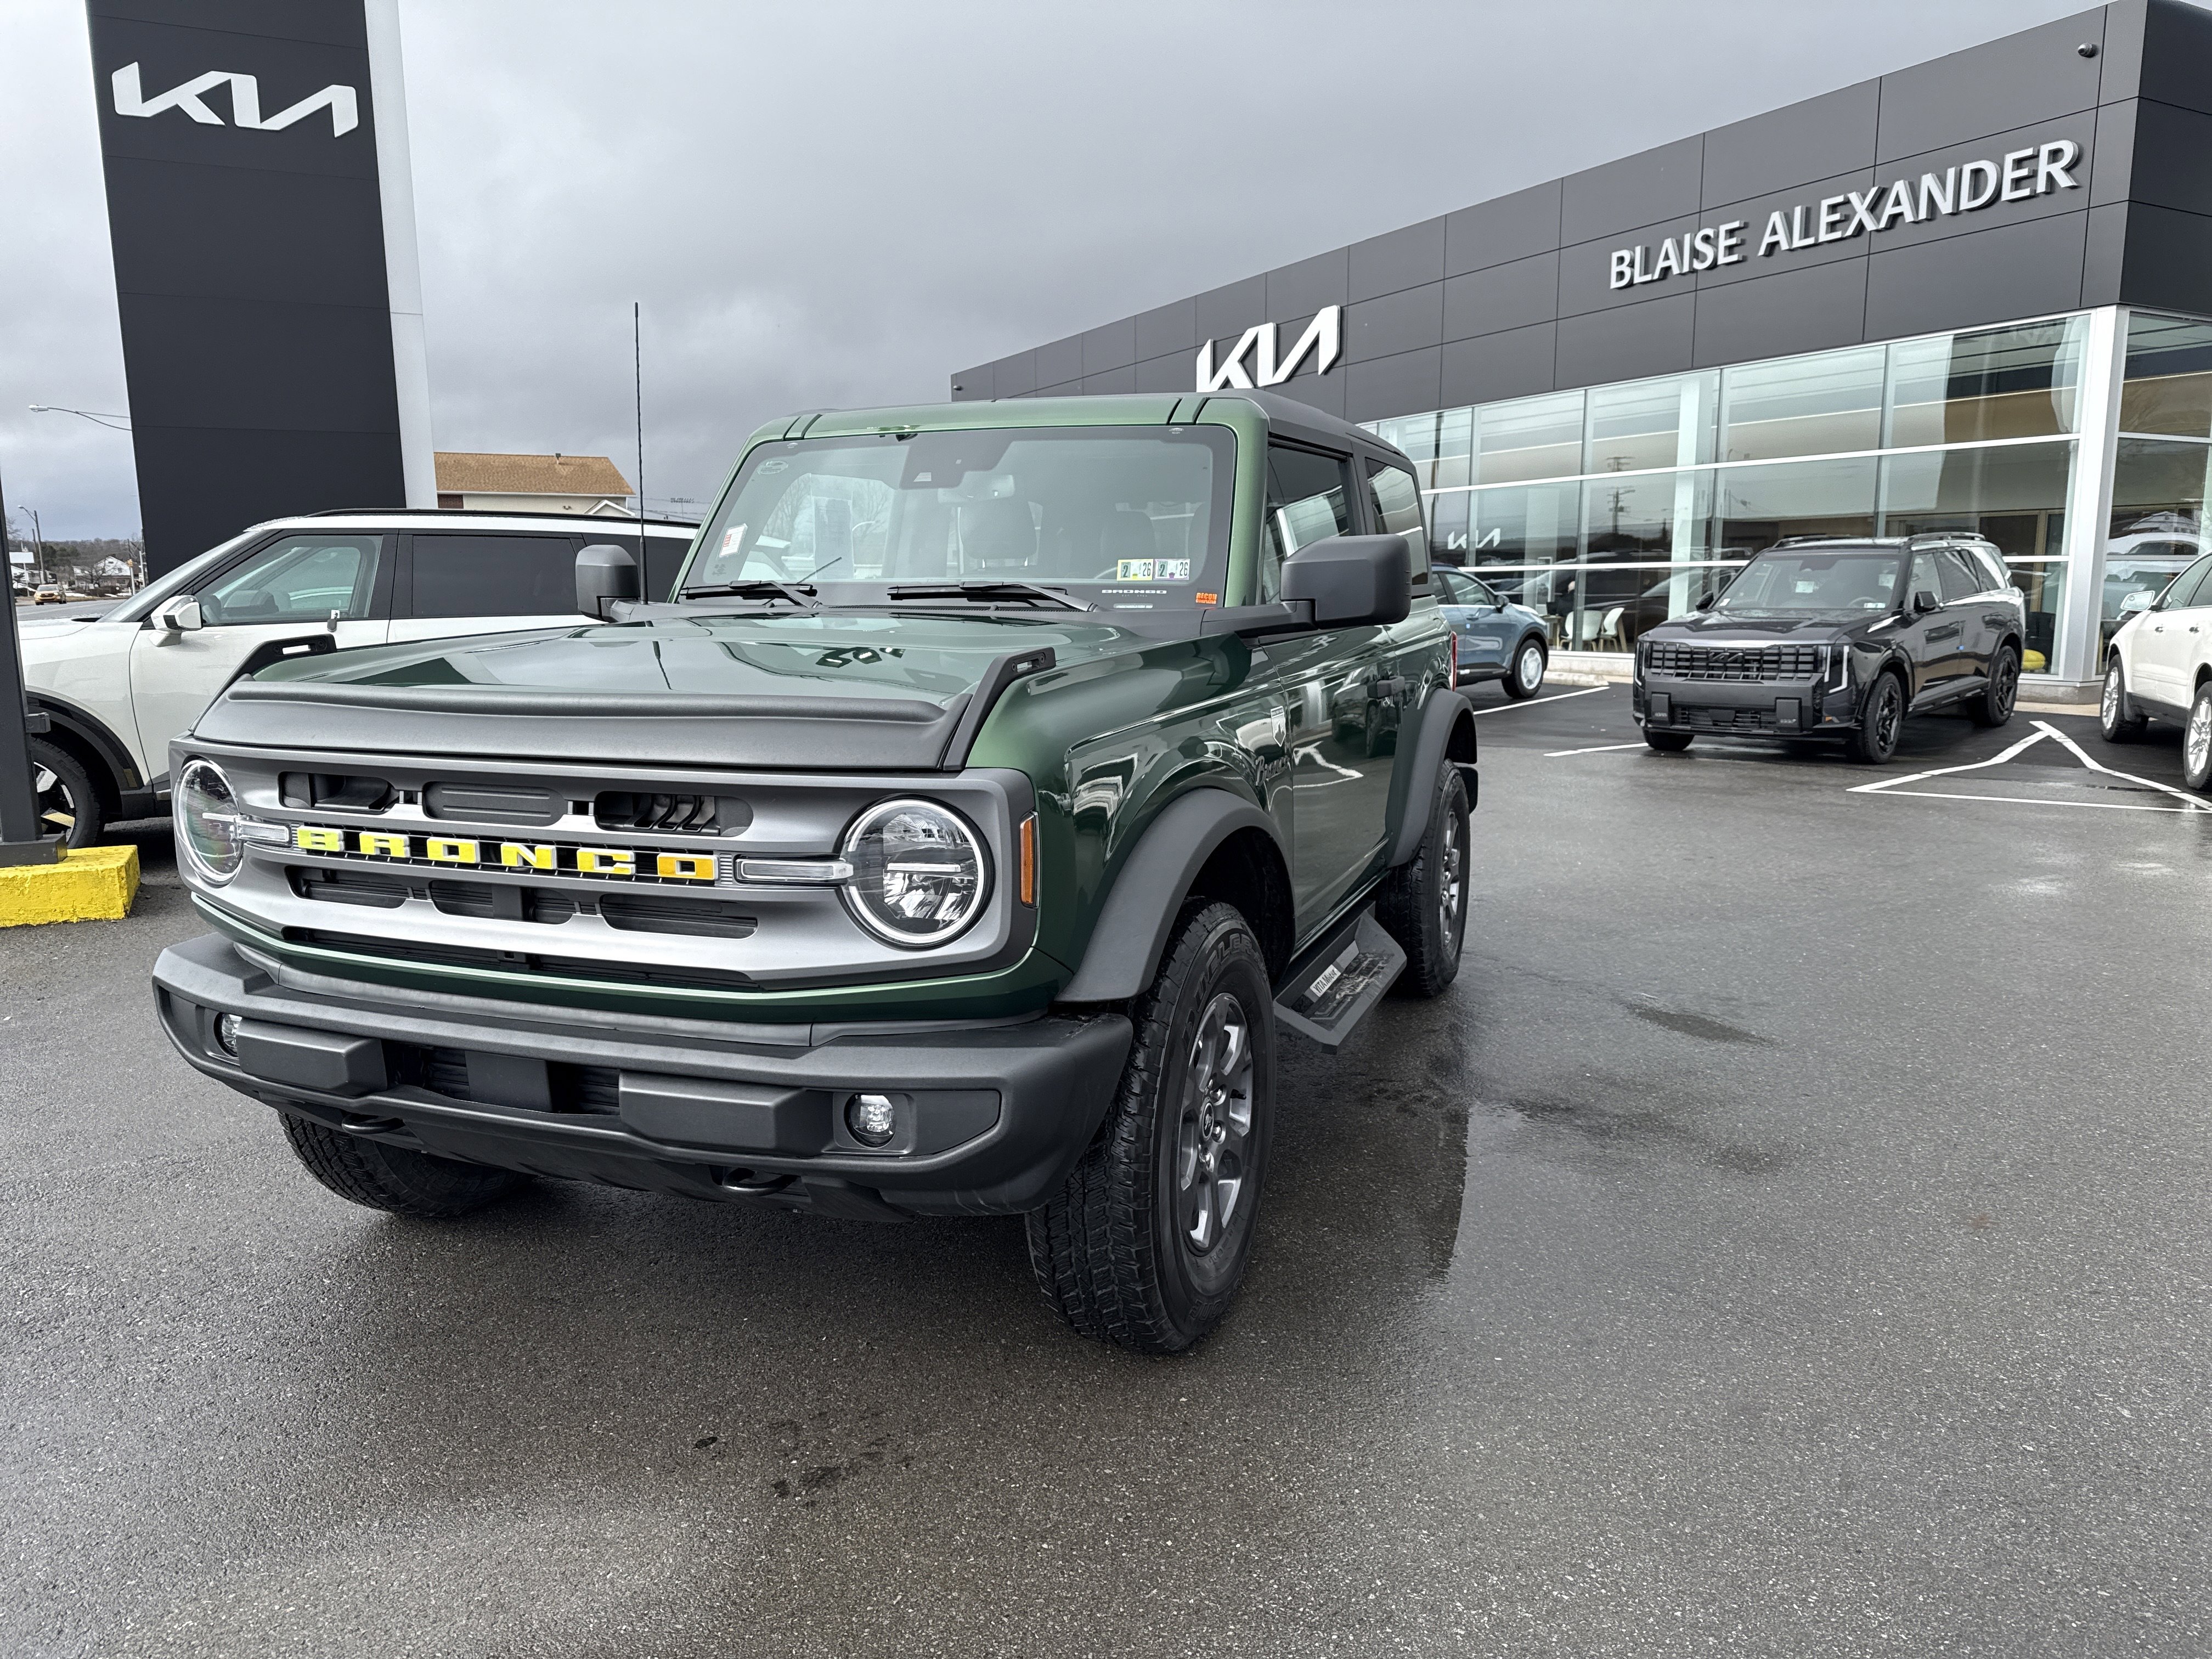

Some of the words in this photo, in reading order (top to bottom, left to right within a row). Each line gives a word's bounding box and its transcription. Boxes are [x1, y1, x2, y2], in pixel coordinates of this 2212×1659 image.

[111, 61, 359, 138] KIA
[1610, 220, 1746, 289] BLAISE
[1758, 138, 2081, 256] ALEXANDER
[1196, 305, 1341, 392] KIA
[1123, 565, 1128, 578] 2
[1143, 562, 1152, 577] 26
[1159, 564, 1165, 577] 2
[1179, 562, 1188, 576] 26
[297, 825, 719, 881] BRONCO
